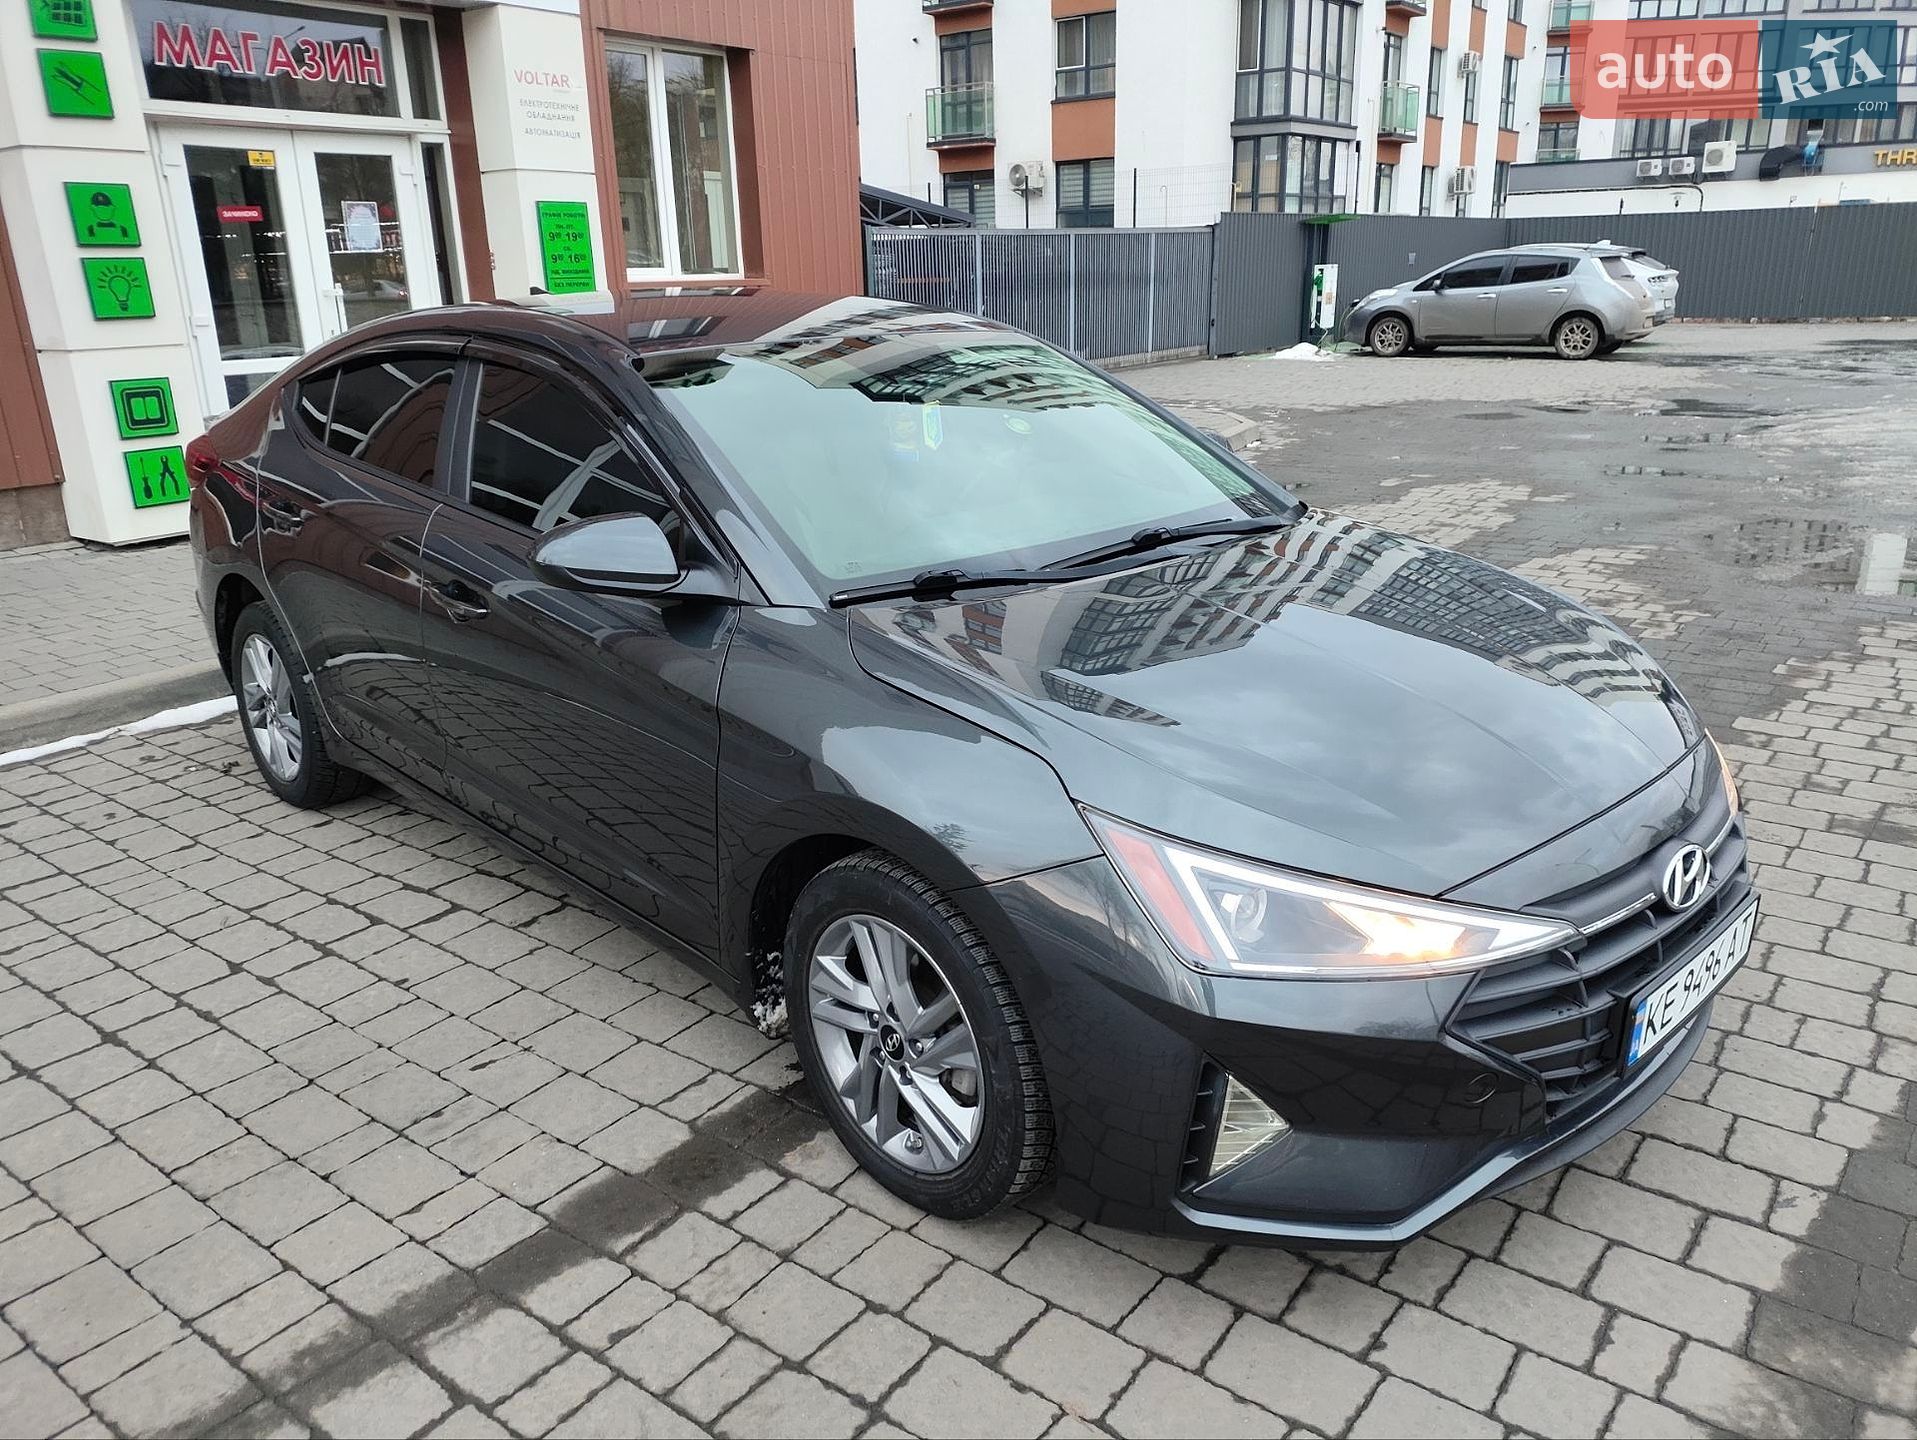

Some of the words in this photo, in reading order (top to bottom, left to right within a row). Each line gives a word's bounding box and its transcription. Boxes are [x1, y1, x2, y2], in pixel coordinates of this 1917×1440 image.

[153, 20, 387, 88] МАГАЗИН
[513, 69, 571, 89] VOLTAR
[1643, 980, 1680, 1046] KE
[1680, 938, 1726, 1014] 9496
[1724, 910, 1754, 970] AT
